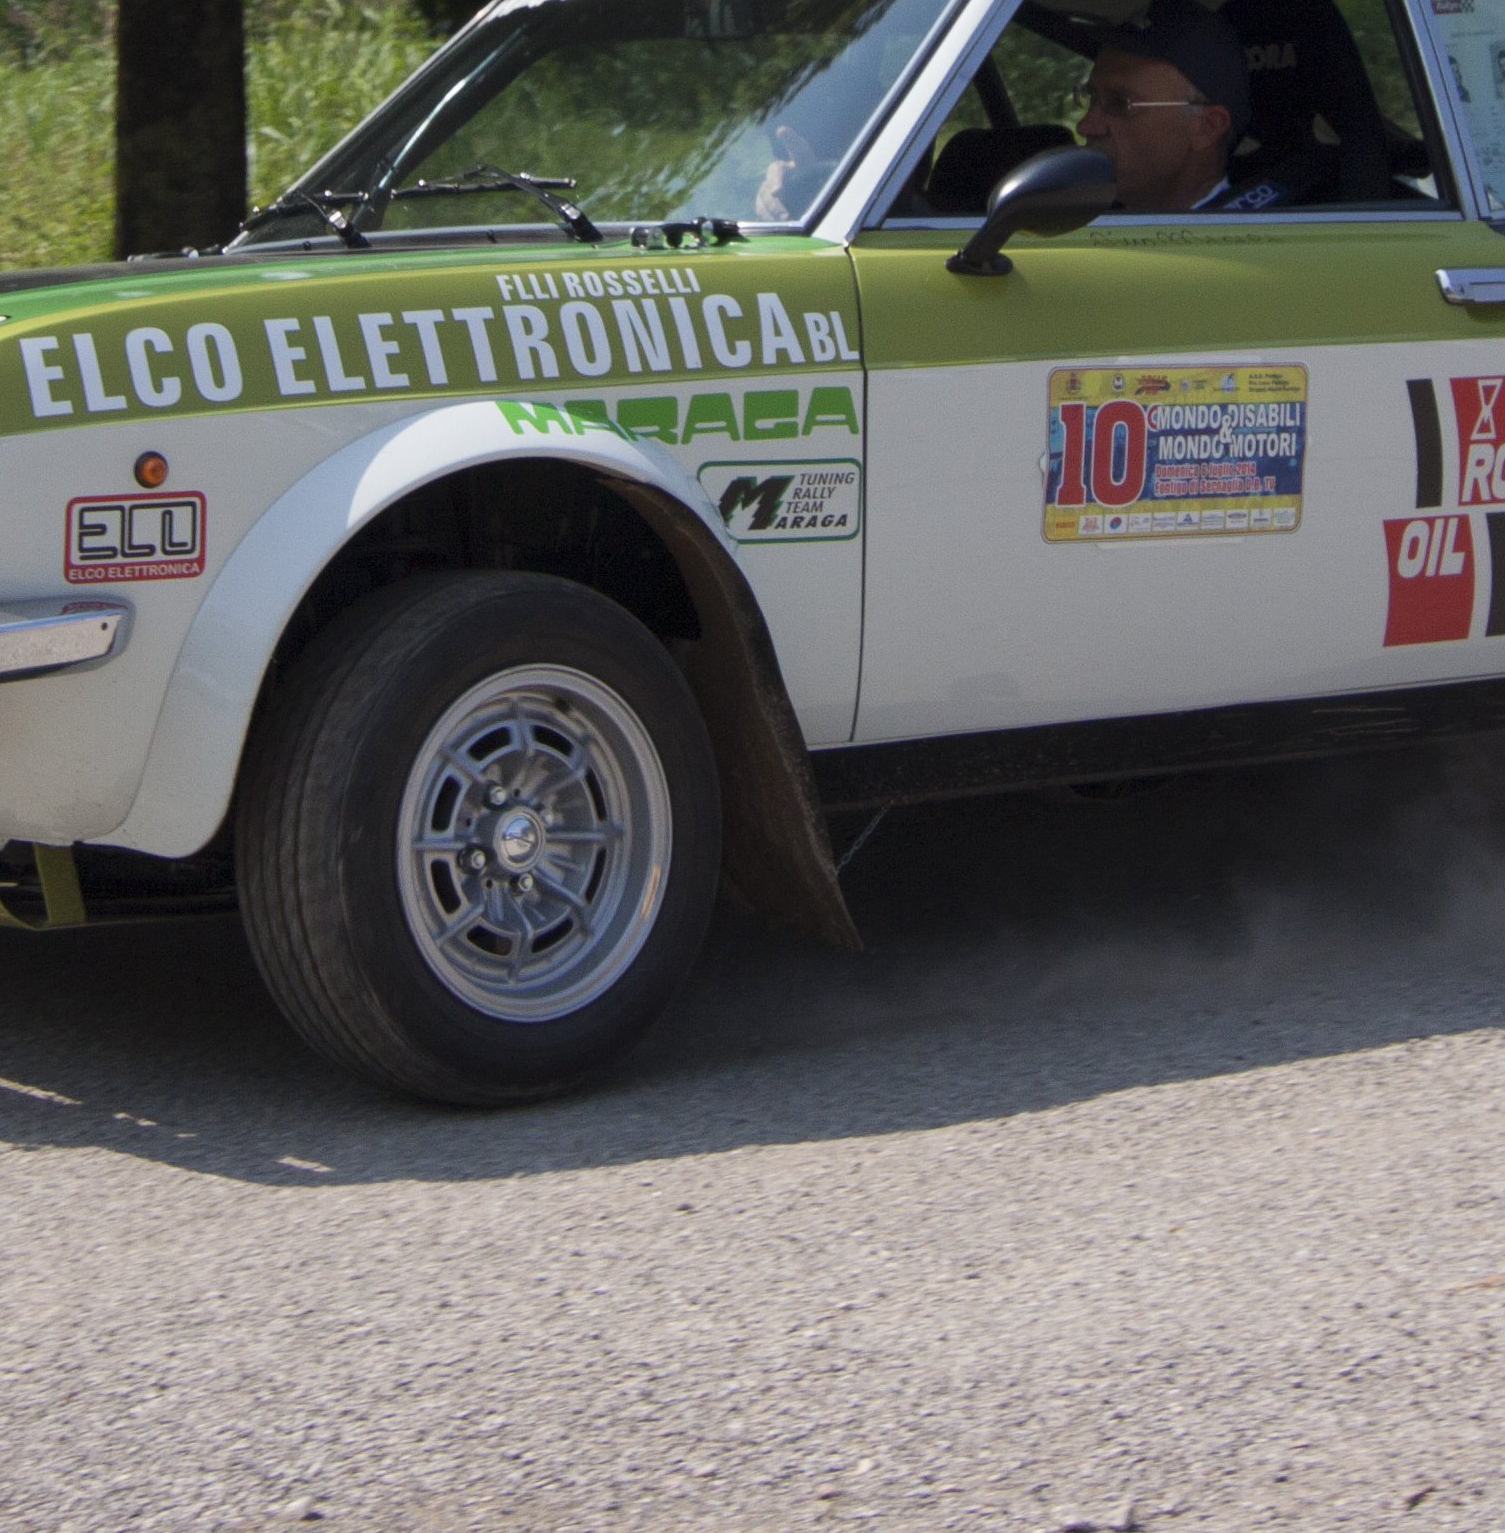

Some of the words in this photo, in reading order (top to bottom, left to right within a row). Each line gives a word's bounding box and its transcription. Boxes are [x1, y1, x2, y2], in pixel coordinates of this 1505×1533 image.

[496, 272, 559, 301] FLLI
[562, 268, 701, 298] ROSSELLI
[18, 323, 243, 418] ELCO
[263, 292, 805, 397] ELETTRONICA
[804, 311, 860, 363] BL
[495, 386, 860, 445] MARAGA
[1156, 404, 1223, 430] MONDO
[1228, 402, 1300, 428] DISABILI
[1158, 435, 1224, 460] MONDO
[1229, 432, 1296, 458] MOTORI
[800, 471, 856, 486] TUNING
[792, 486, 837, 500] RALLY
[786, 501, 824, 514] TEAM
[1398, 517, 1466, 579] OIL
[69, 567, 105, 581] ELCO
[107, 562, 201, 579] ELETTRONICA
